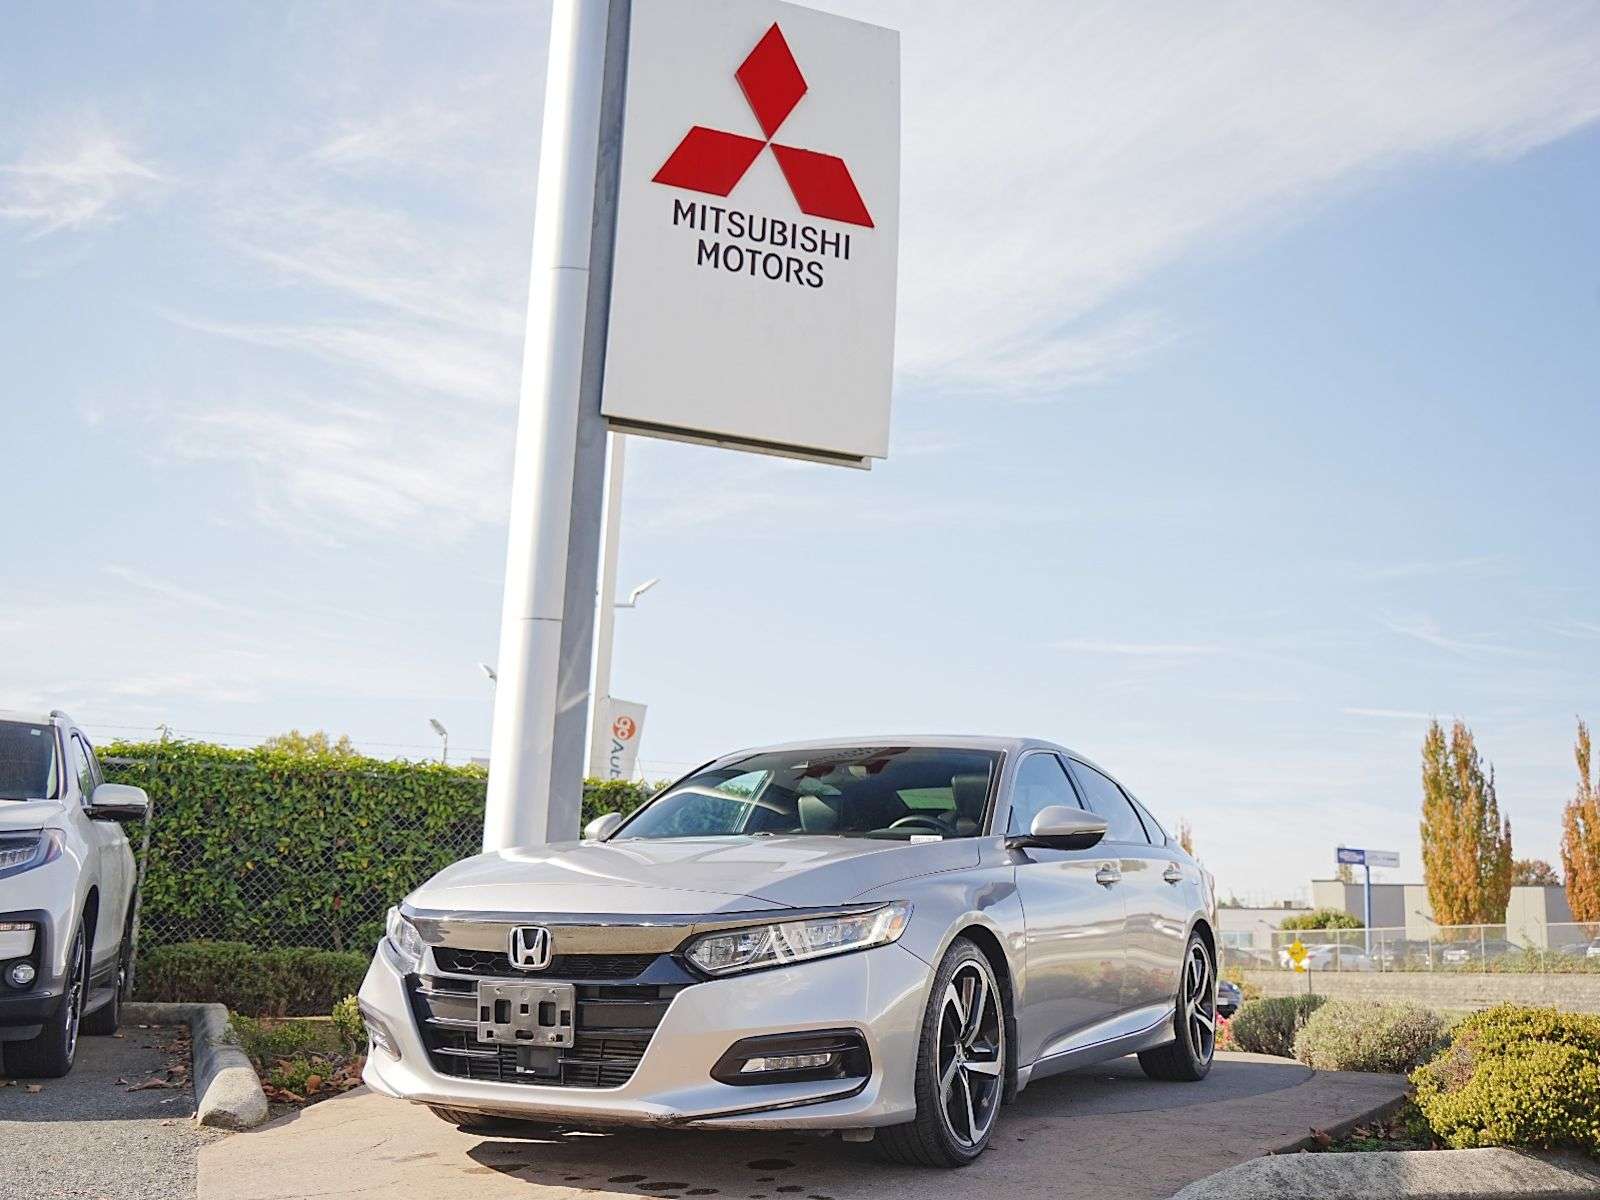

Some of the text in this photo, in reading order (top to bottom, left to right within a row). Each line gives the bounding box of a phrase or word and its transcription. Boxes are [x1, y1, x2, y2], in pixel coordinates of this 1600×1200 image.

[673, 198, 850, 260] MITSUBISHI
[697, 238, 824, 288] MOTORS
[609, 738, 624, 780] Aut
